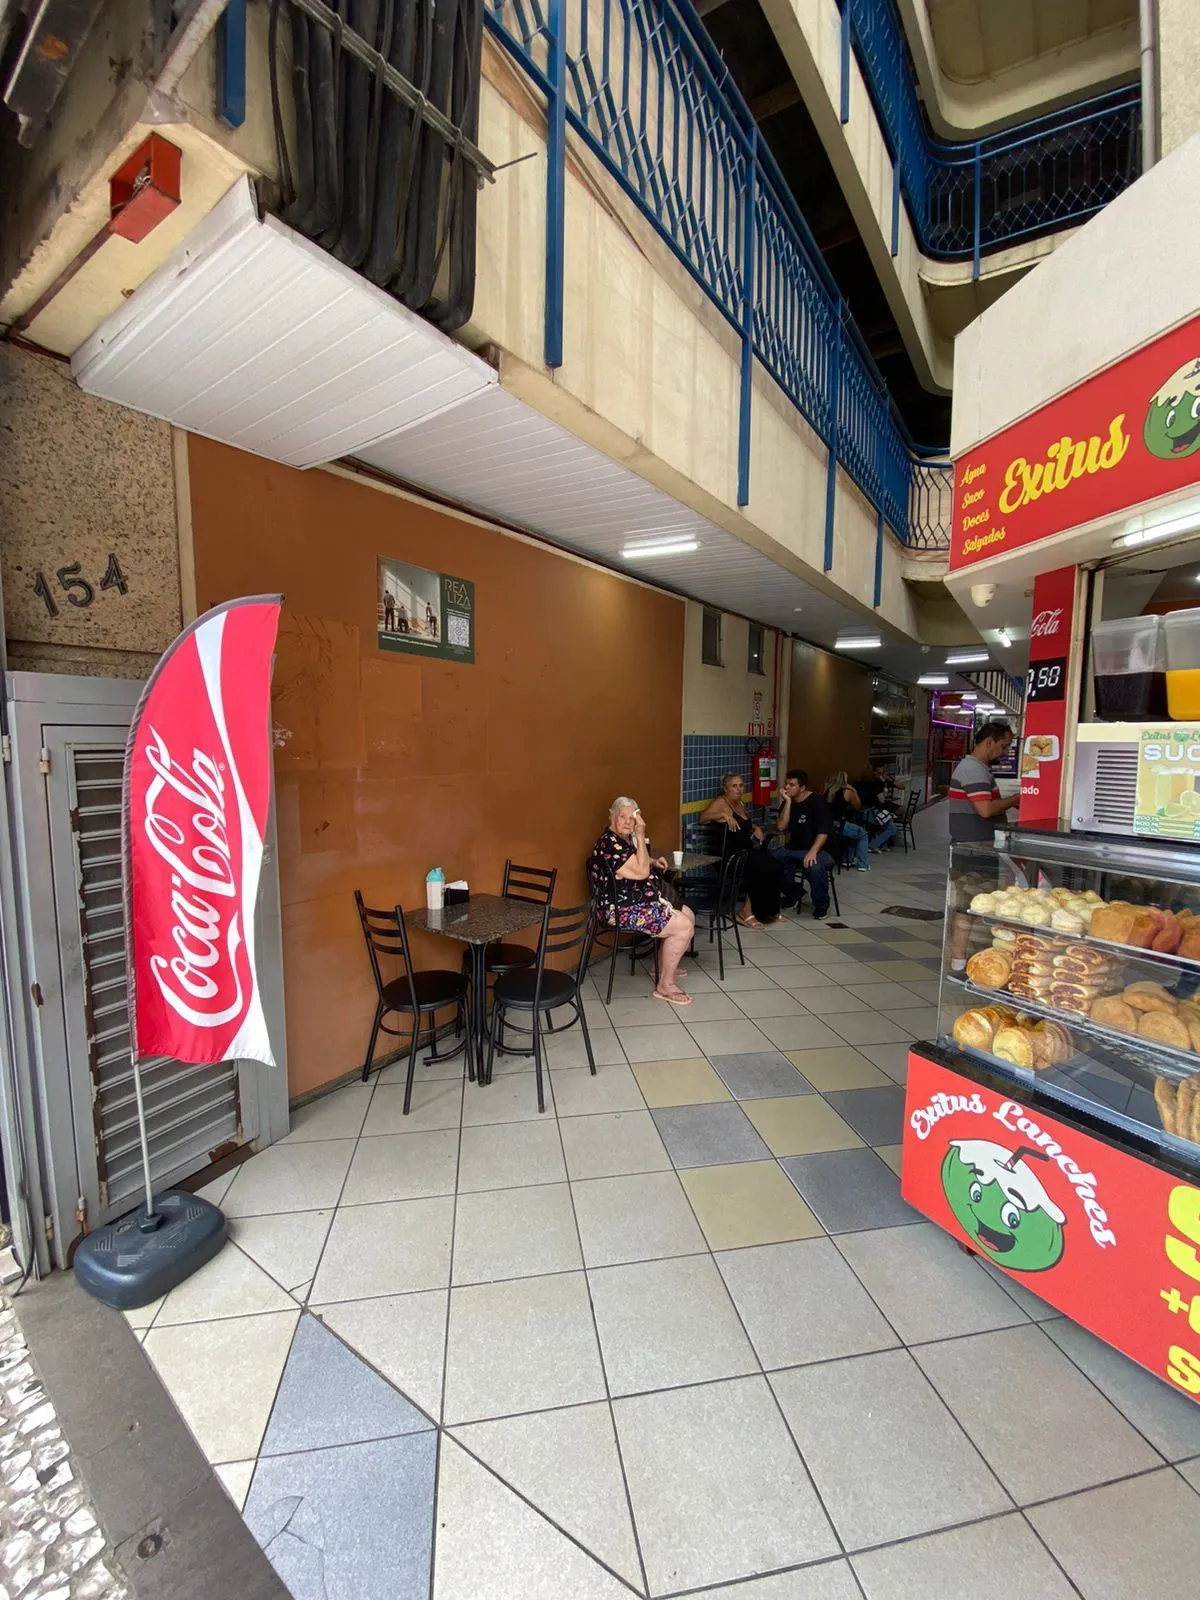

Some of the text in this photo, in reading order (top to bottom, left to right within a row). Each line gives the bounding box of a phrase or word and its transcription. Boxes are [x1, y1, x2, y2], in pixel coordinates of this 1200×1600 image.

[960, 464, 986, 488] Água
[998, 413, 1131, 514] Exitus
[962, 488, 985, 509] Suco
[962, 508, 990, 531] Doces
[962, 526, 1006, 555] Salgados
[33, 553, 128, 617] 154
[444, 578, 468, 596] REA
[144, 723, 243, 1028] Coca-Cola
[910, 1091, 987, 1141] Exitus
[992, 1101, 1117, 1249] Lanches
